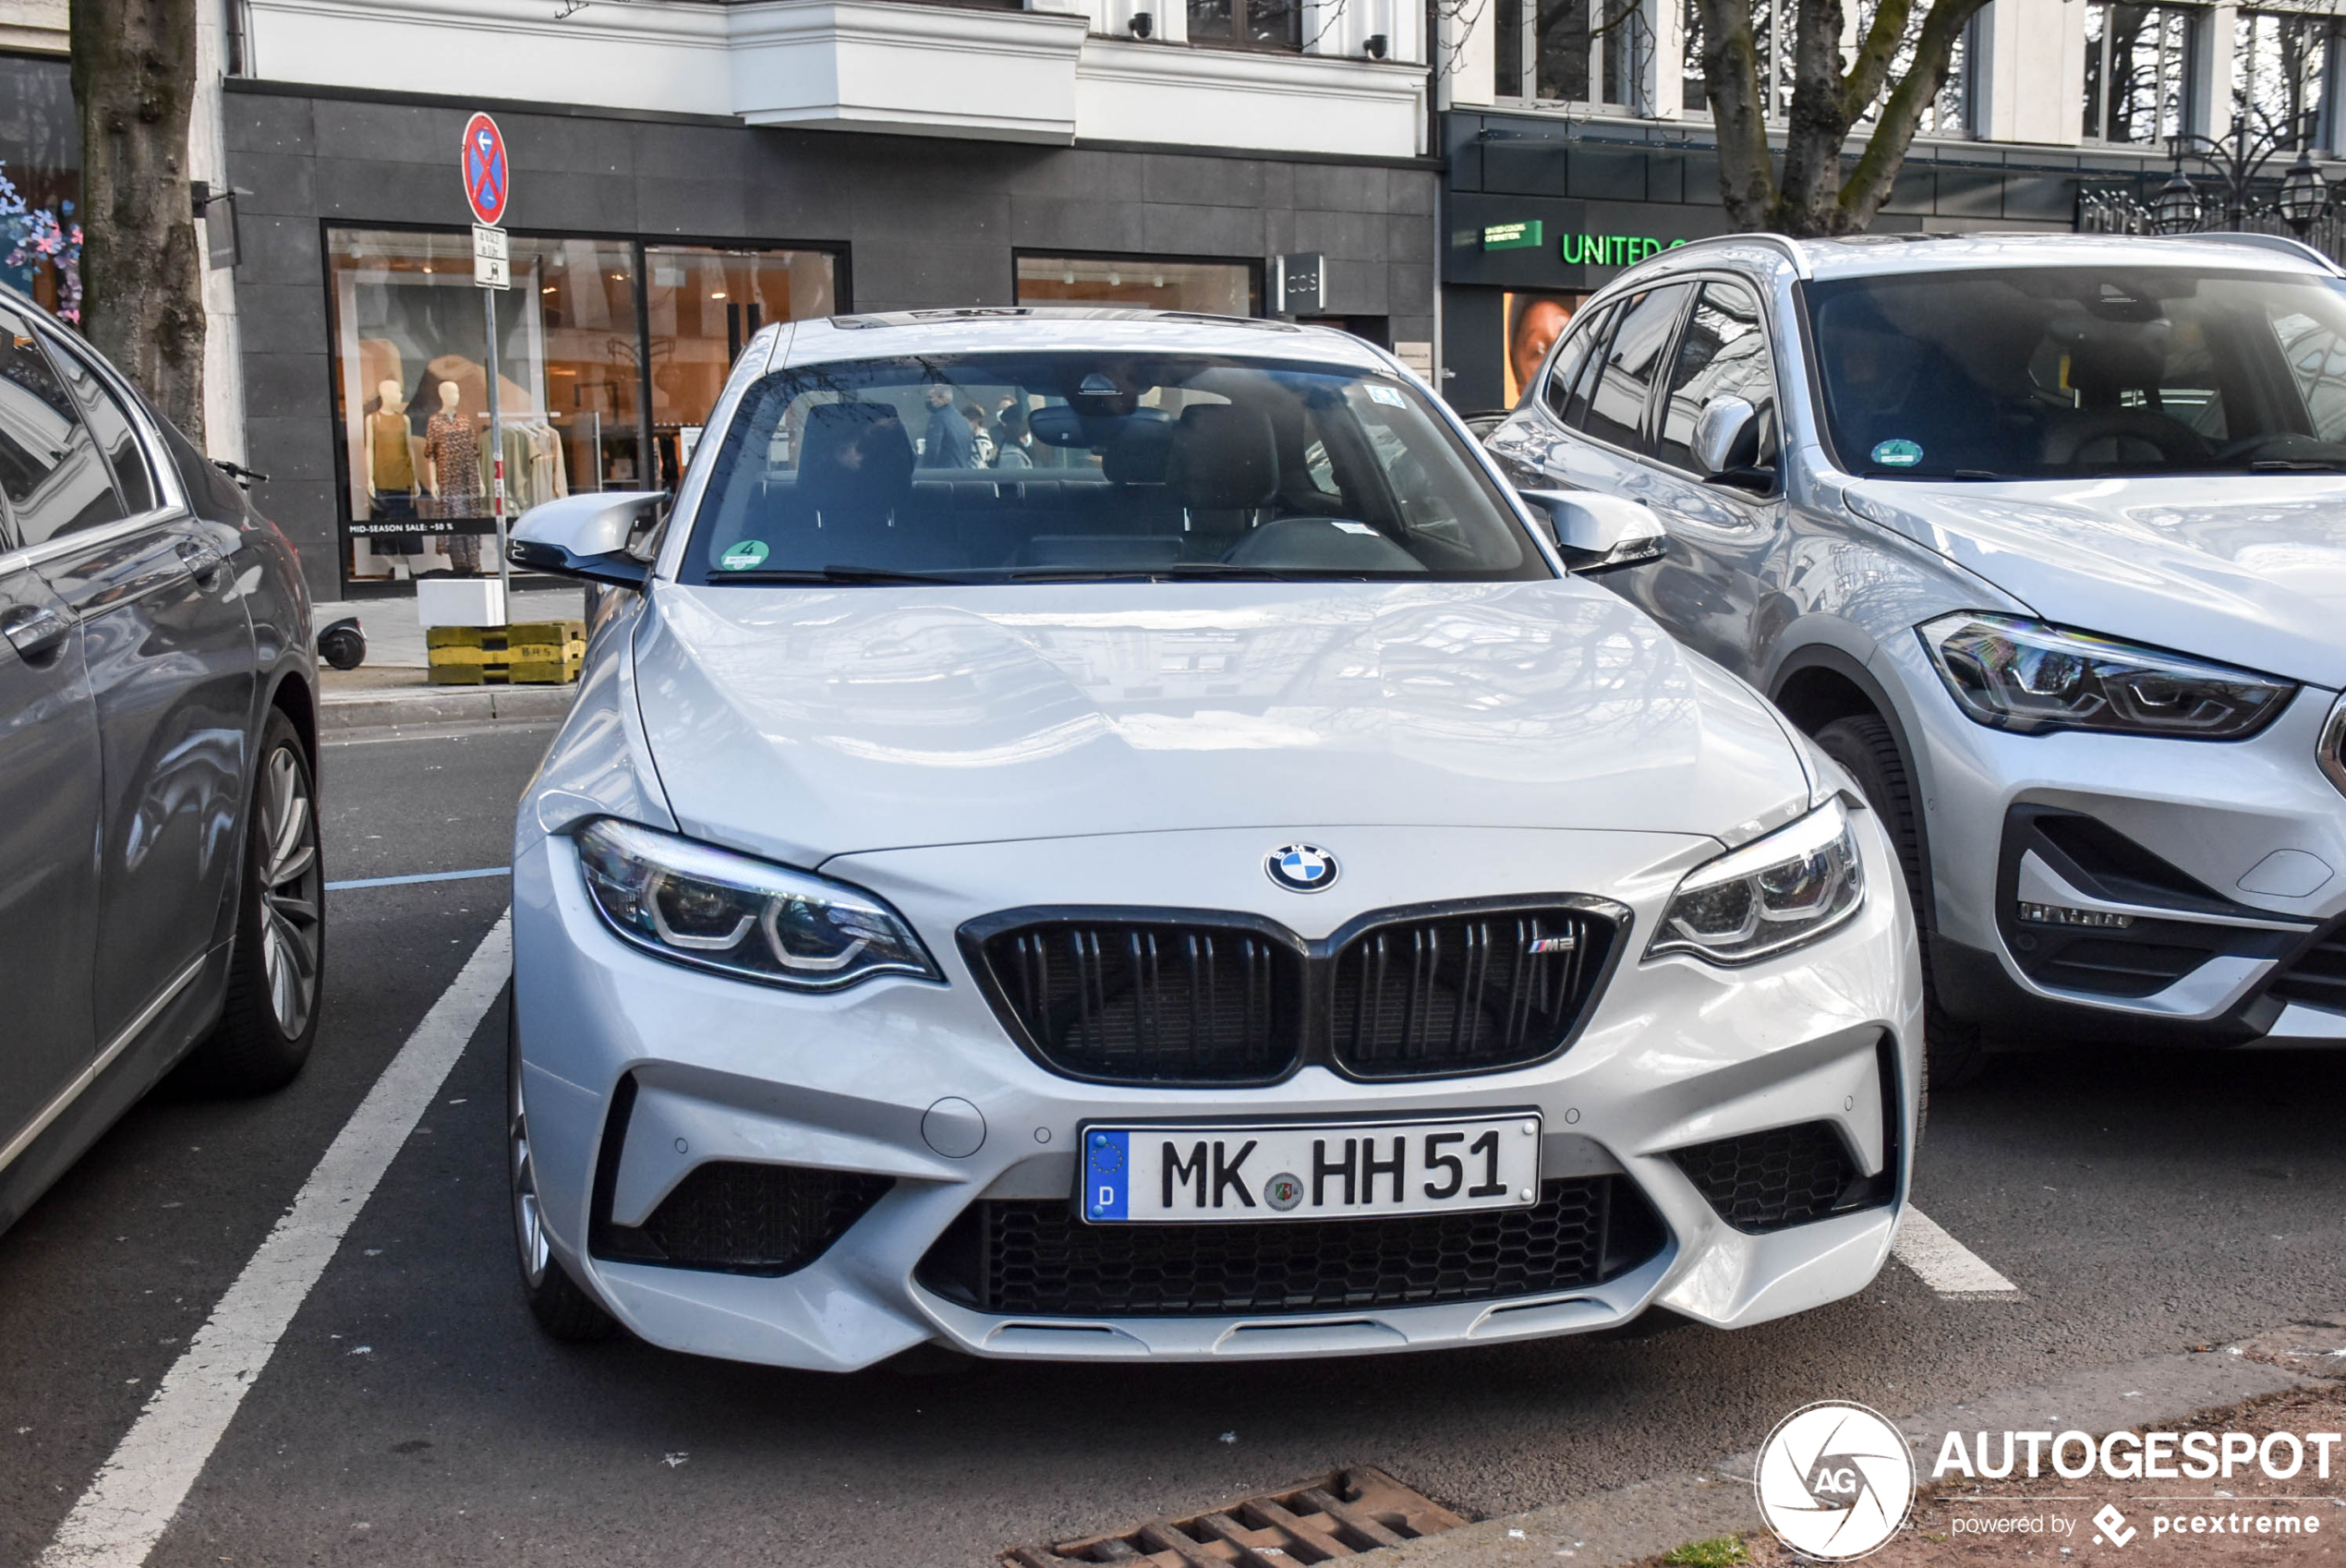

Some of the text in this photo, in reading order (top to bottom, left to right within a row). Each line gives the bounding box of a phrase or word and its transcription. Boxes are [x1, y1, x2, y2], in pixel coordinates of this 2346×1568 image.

[1563, 234, 1662, 265] UNITED
[1288, 273, 1317, 293] COS
[1892, 443, 1903, 455] 4
[349, 525, 404, 533] MID-SEASON
[405, 524, 428, 532] SALE:
[739, 541, 755, 555] 4
[1271, 845, 1331, 860] BMW
[1541, 937, 1574, 952] M2
[1099, 1187, 1114, 1205] D
[1162, 1139, 1258, 1208] MK
[1312, 1136, 1407, 1206] HH
[1423, 1130, 1507, 1200] 51
